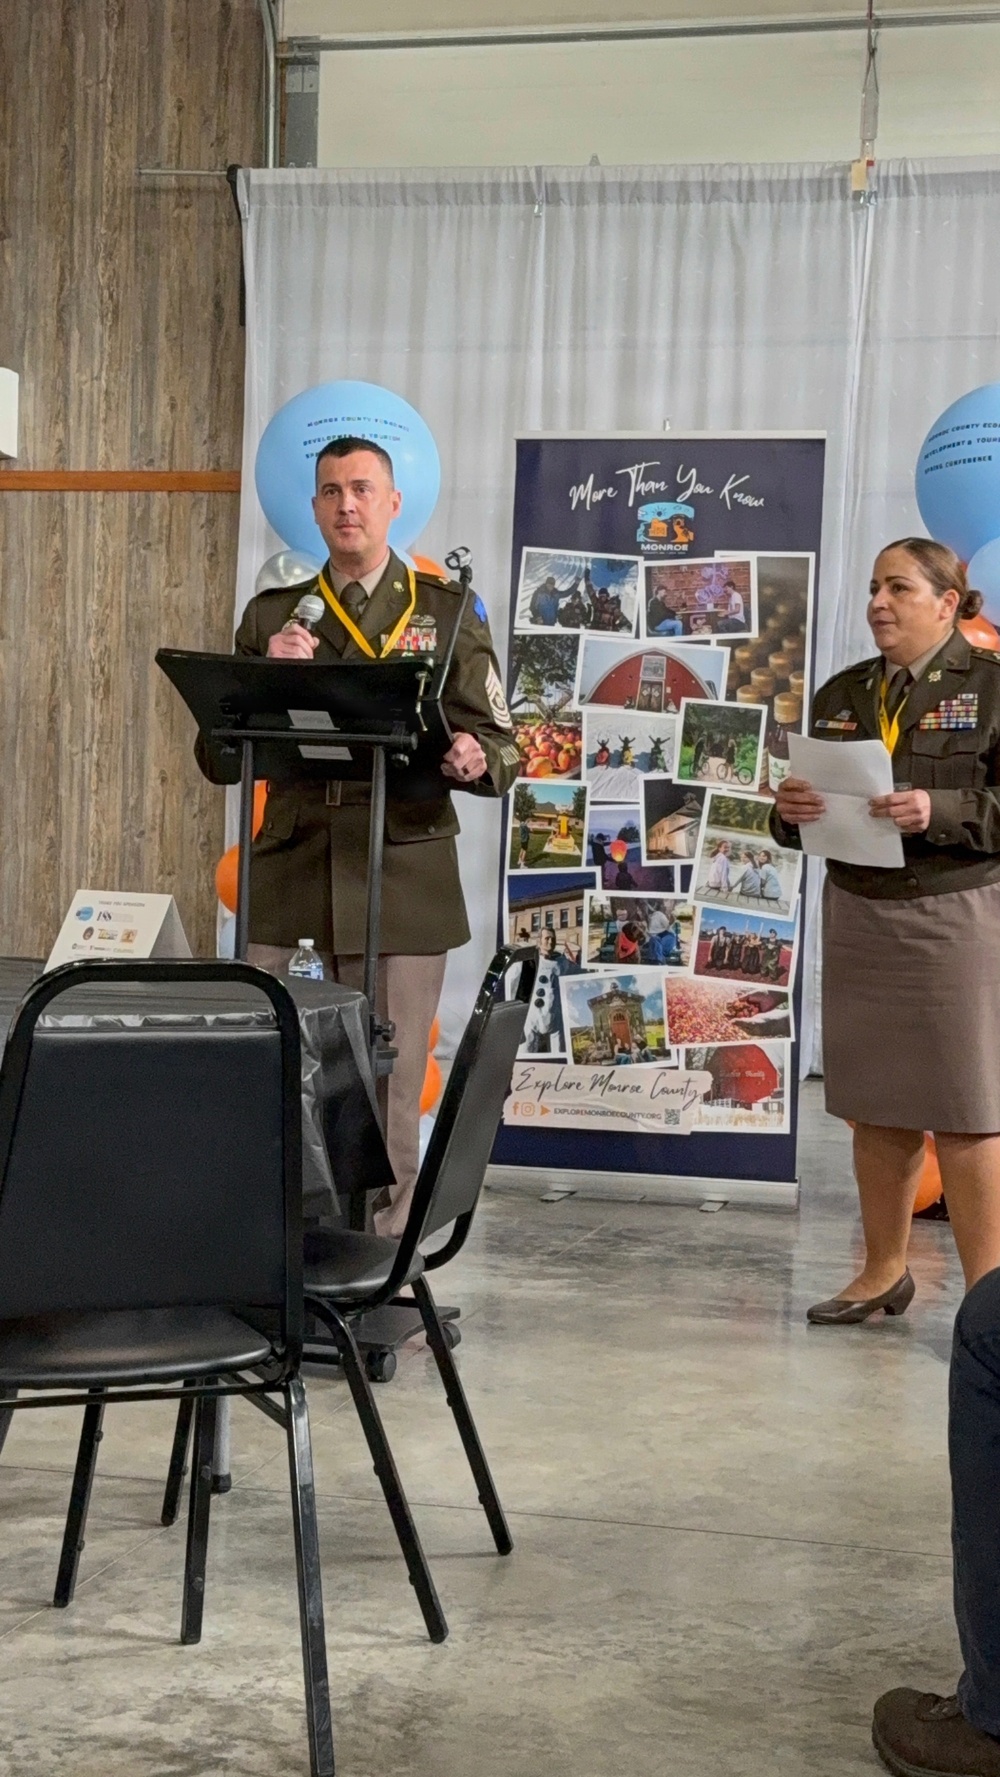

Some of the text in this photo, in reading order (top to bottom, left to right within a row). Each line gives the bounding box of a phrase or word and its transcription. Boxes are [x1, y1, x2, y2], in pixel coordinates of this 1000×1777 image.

[951, 423, 980, 432] COUNTY
[924, 439, 966, 460] DEVELOPMENT
[924, 455, 992, 475] SPRING CONFERENCE
[569, 461, 765, 510] More Than You Know
[641, 543, 689, 551] MONROE
[515, 1066, 699, 1112] Explore Monroe County
[553, 1107, 662, 1120] EXPLOREMONROECOUNTY.ORG
